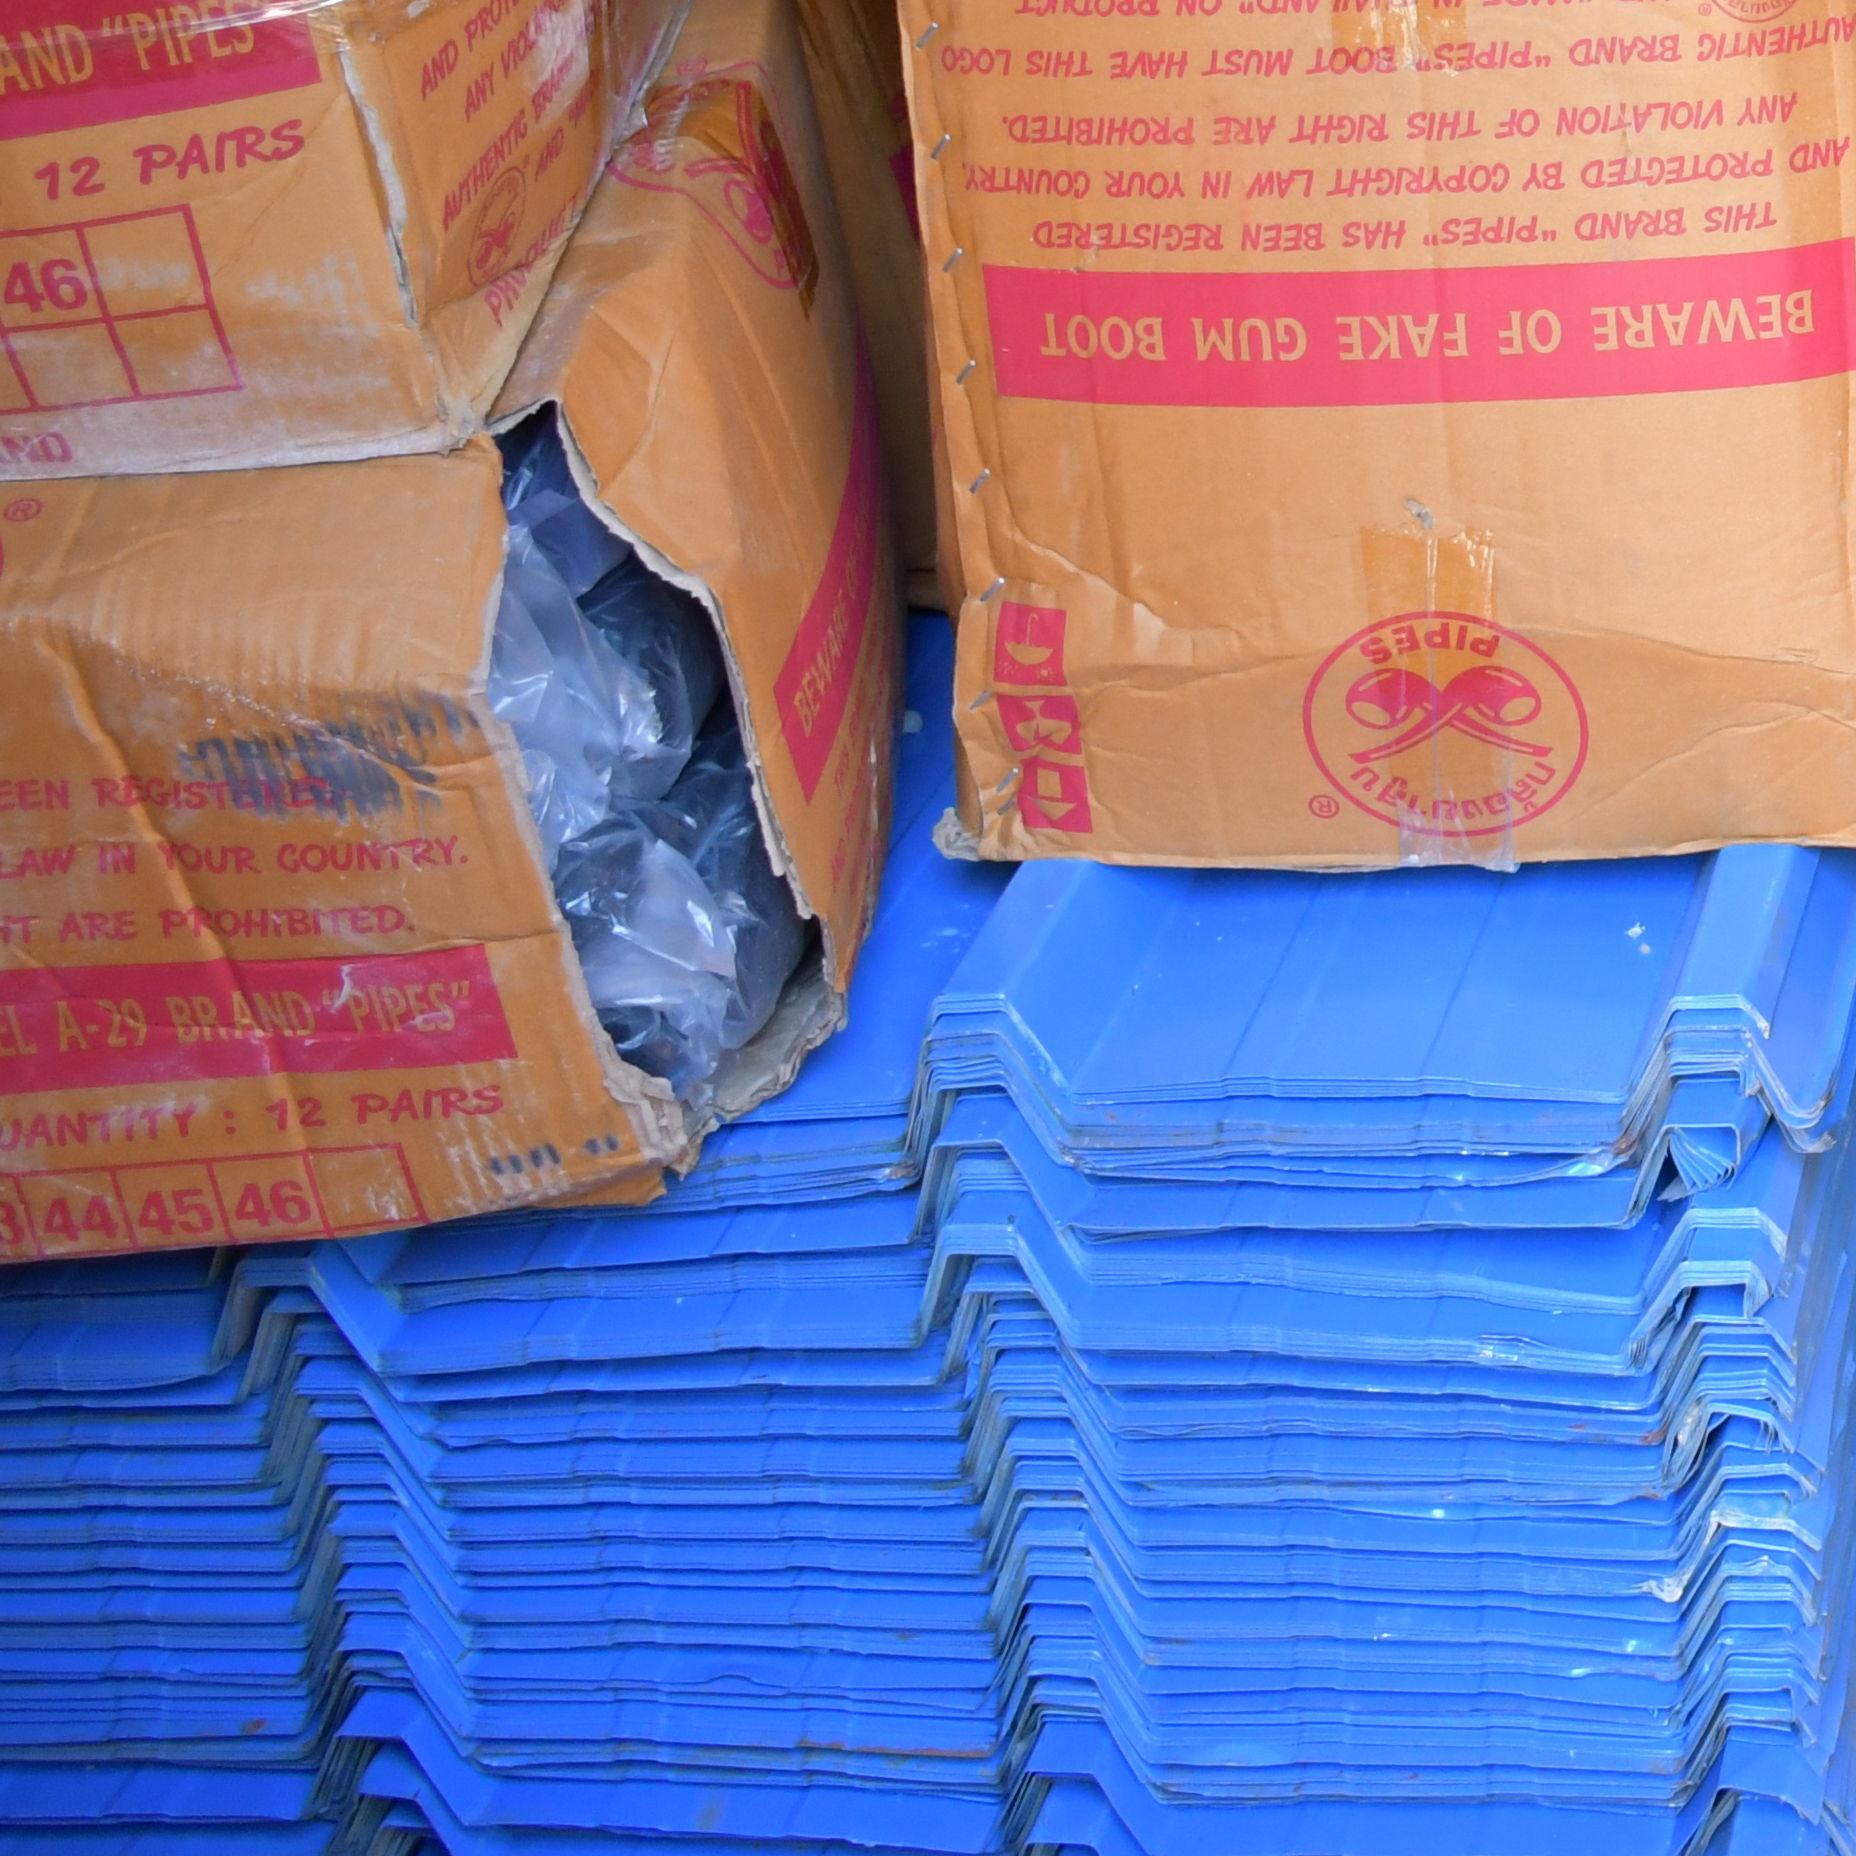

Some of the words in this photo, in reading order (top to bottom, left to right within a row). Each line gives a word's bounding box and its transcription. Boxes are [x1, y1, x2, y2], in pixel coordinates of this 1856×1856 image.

[417, 38, 460, 103] AND
[33, 155, 105, 201] 12
[131, 116, 305, 186] PAIRS
[441, 110, 529, 233] AUTHENTIC
[1521, 160, 1566, 192] BY
[1579, 148, 1774, 190] PROTECTED
[1788, 135, 1852, 174] AND
[957, 165, 1092, 200] COUNTRY.
[1104, 170, 1185, 201] YOUR
[1200, 170, 1233, 199] IN
[1244, 168, 1315, 201] LAW
[1326, 162, 1511, 198] COPYRIGHT
[2, 256, 90, 313] 46
[1040, 313, 1165, 361] BOOT
[1193, 317, 1307, 362] GUM
[1337, 312, 1468, 361] FAKE
[1499, 309, 1562, 355] OF
[1592, 289, 1814, 351] BEWARE
[1357, 616, 1503, 666] PIPES
[96, 843, 137, 876] IN
[158, 842, 259, 875] YOUR
[275, 835, 467, 875] COUNTRY.
[56, 998, 148, 1052] A-29
[267, 1096, 327, 1133] 12
[351, 1084, 504, 1126] PAIRS
[42, 1195, 119, 1241] 44
[136, 1188, 214, 1237] 45
[233, 1180, 311, 1229] 46
